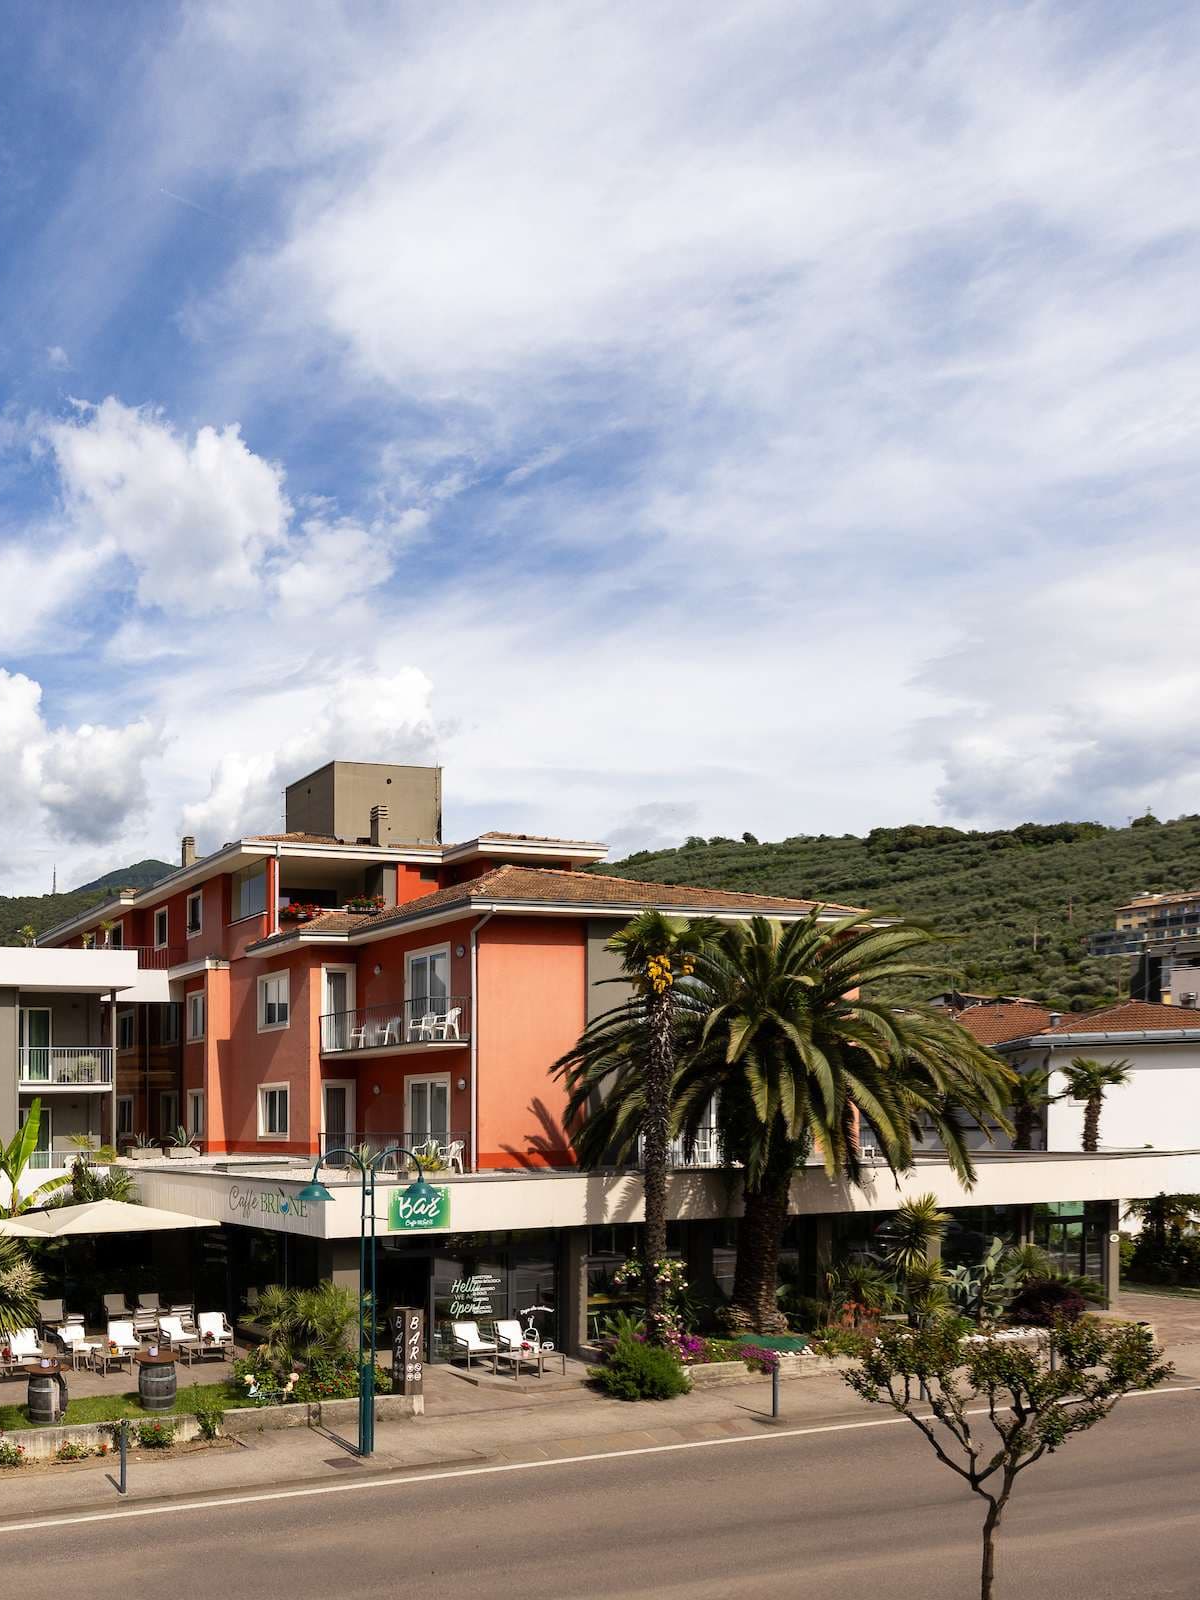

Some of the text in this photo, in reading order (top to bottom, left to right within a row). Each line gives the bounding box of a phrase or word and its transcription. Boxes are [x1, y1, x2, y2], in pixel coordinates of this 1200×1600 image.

[398, 1196, 441, 1219] Bar
[395, 1315, 404, 1360] BAR
[408, 1316, 421, 1360] BAR
